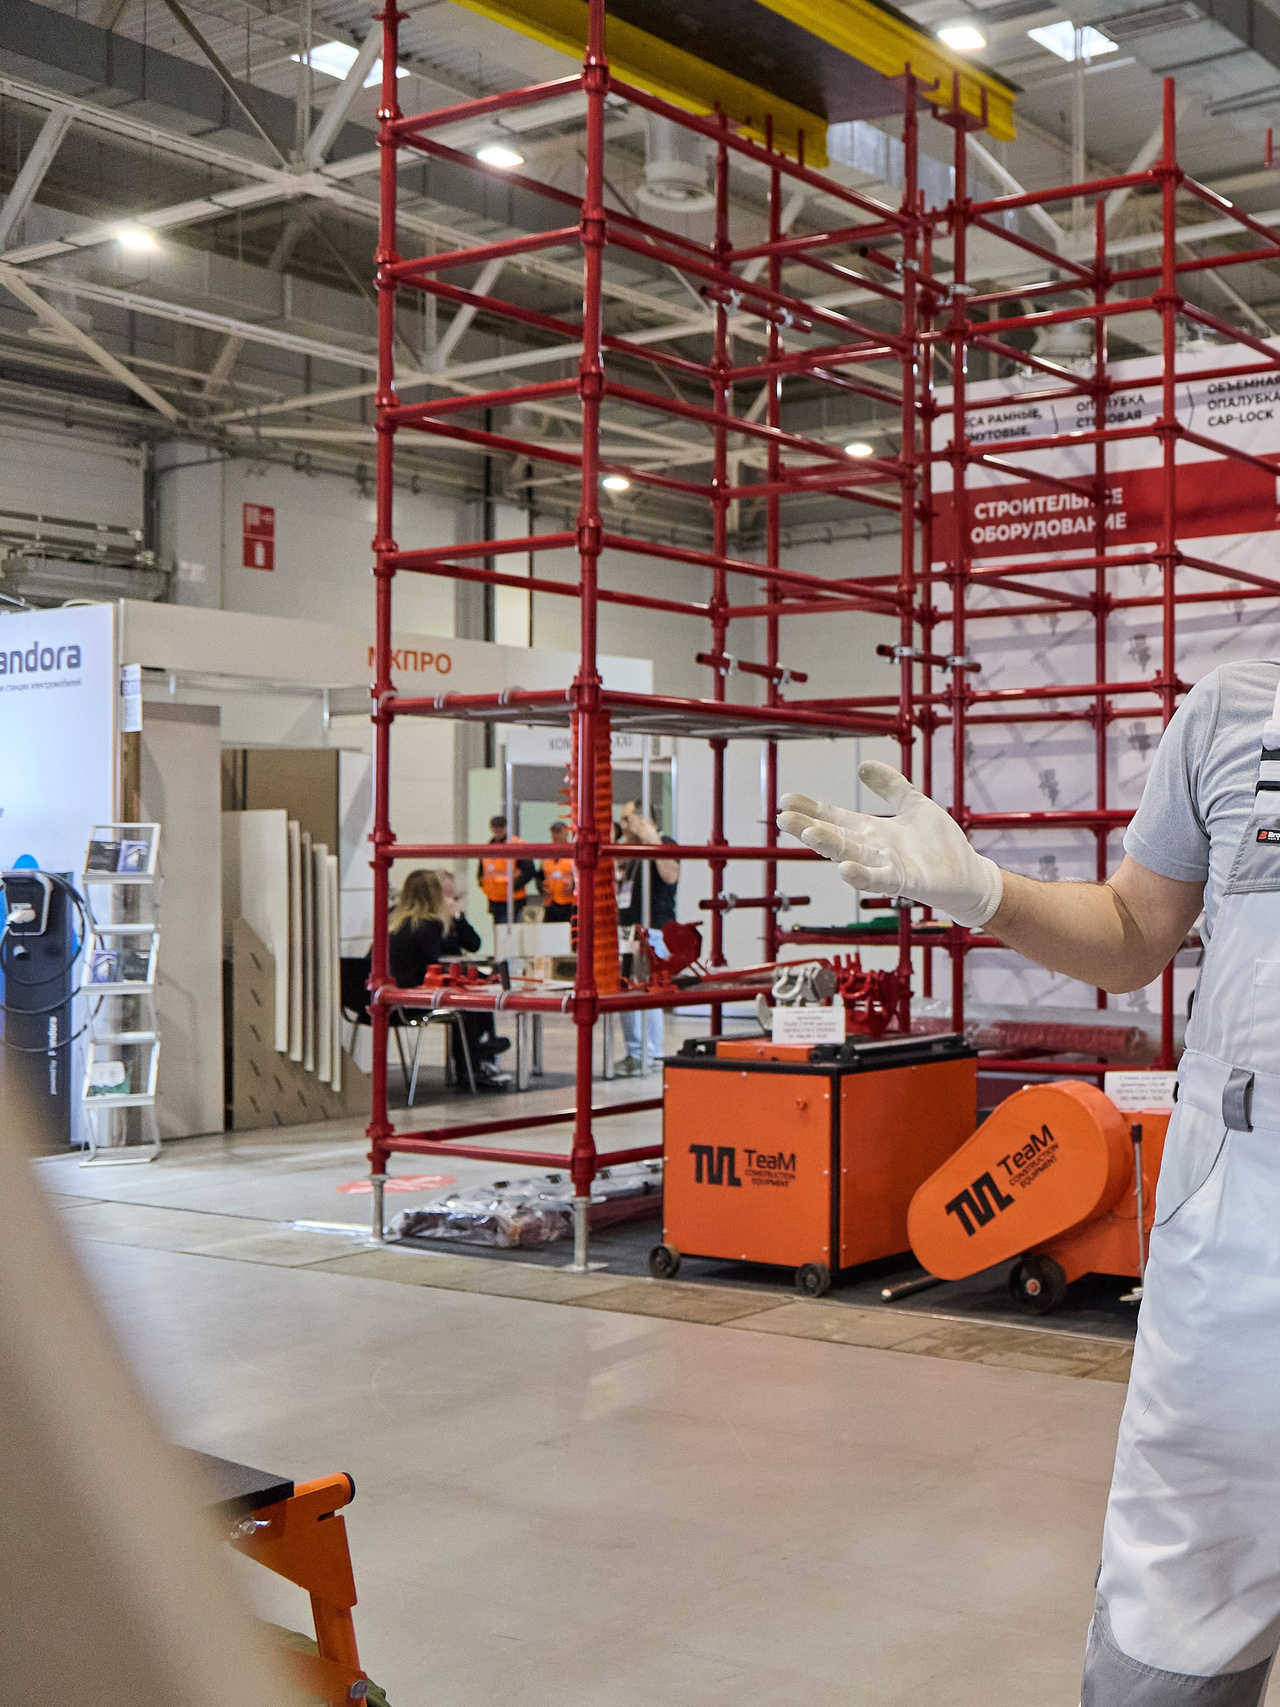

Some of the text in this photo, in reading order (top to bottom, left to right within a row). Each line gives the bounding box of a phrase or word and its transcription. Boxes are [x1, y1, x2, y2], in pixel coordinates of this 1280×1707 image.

[1207, 409, 1274, 427] CAP-LOCK
[974, 487, 1124, 520] СТРОИТЕЛЬЕ
[368, 645, 452, 675] КПРО
[743, 1148, 796, 1171] TeaM
[996, 1124, 1054, 1176] TeaM
